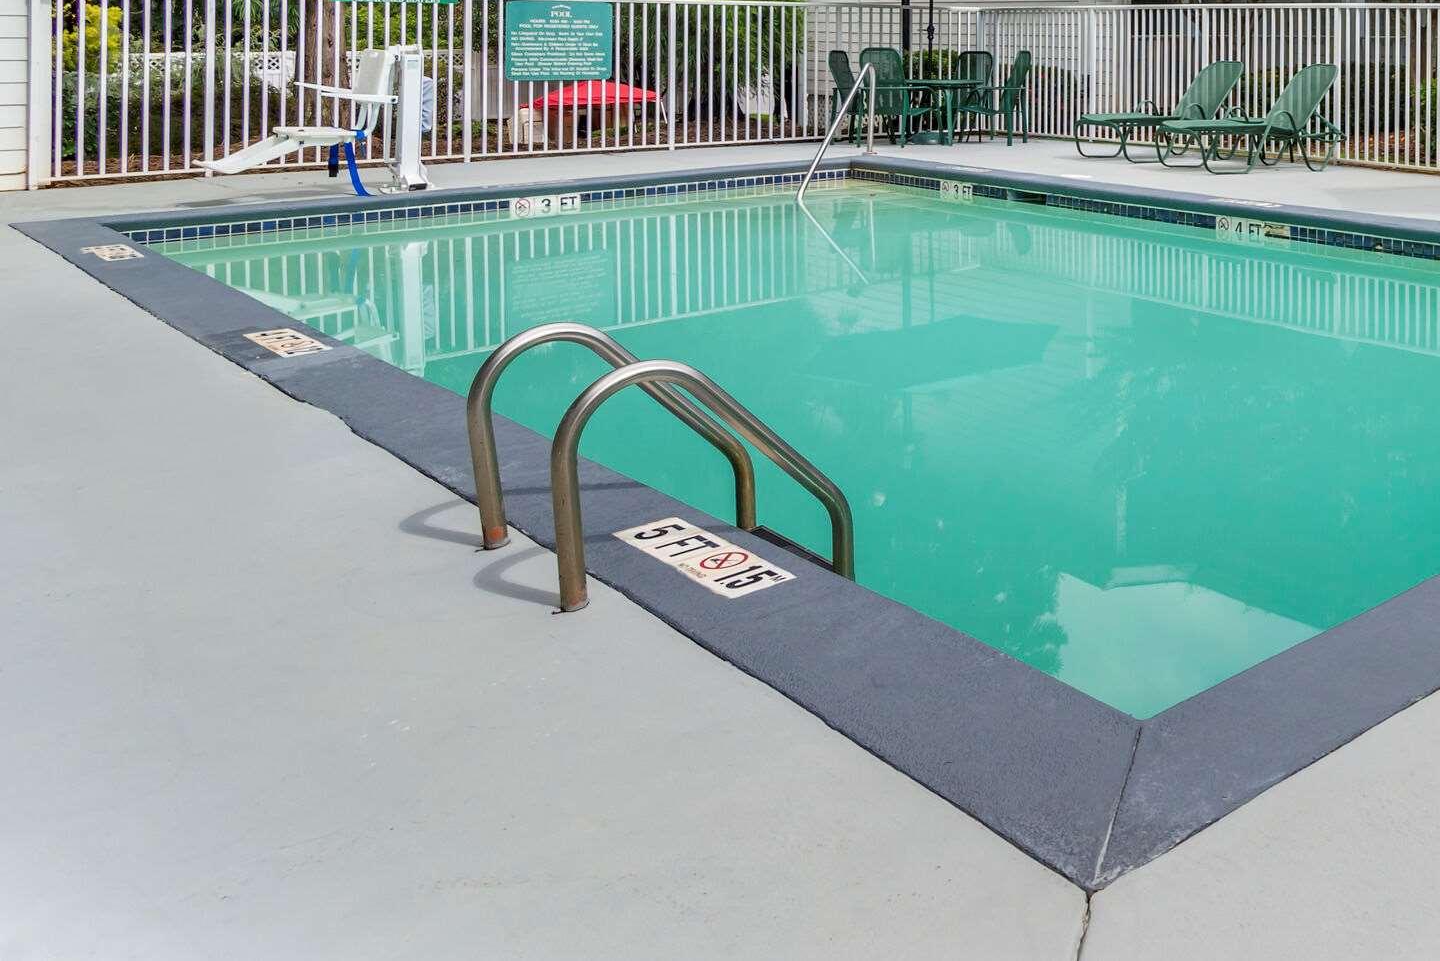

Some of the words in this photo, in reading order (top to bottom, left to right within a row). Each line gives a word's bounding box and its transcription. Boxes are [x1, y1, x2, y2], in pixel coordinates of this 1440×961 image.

[550, 10, 573, 18] POOL
[633, 523, 686, 540] 5
[654, 535, 721, 558] FT
